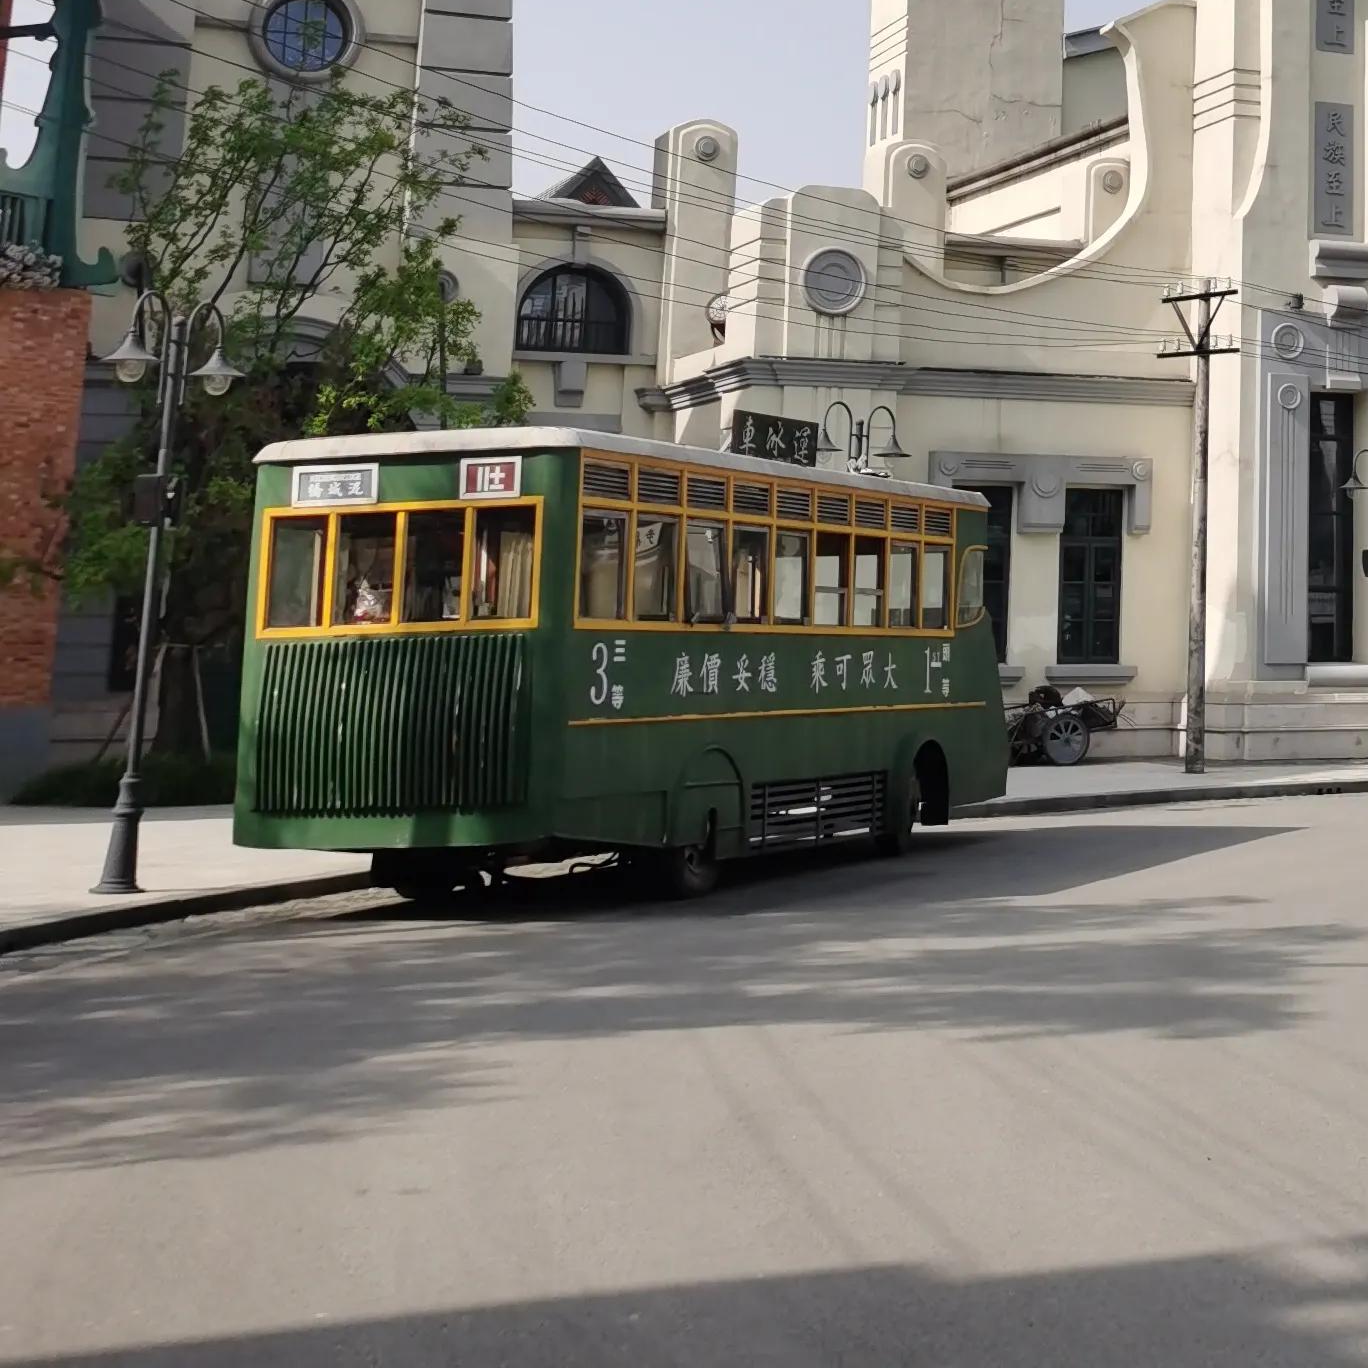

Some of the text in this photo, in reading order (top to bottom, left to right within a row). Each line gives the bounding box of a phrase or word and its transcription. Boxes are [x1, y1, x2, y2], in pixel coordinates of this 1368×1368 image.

[1321, 110, 1345, 229] 民族至上
[590, 642, 608, 705] 3
